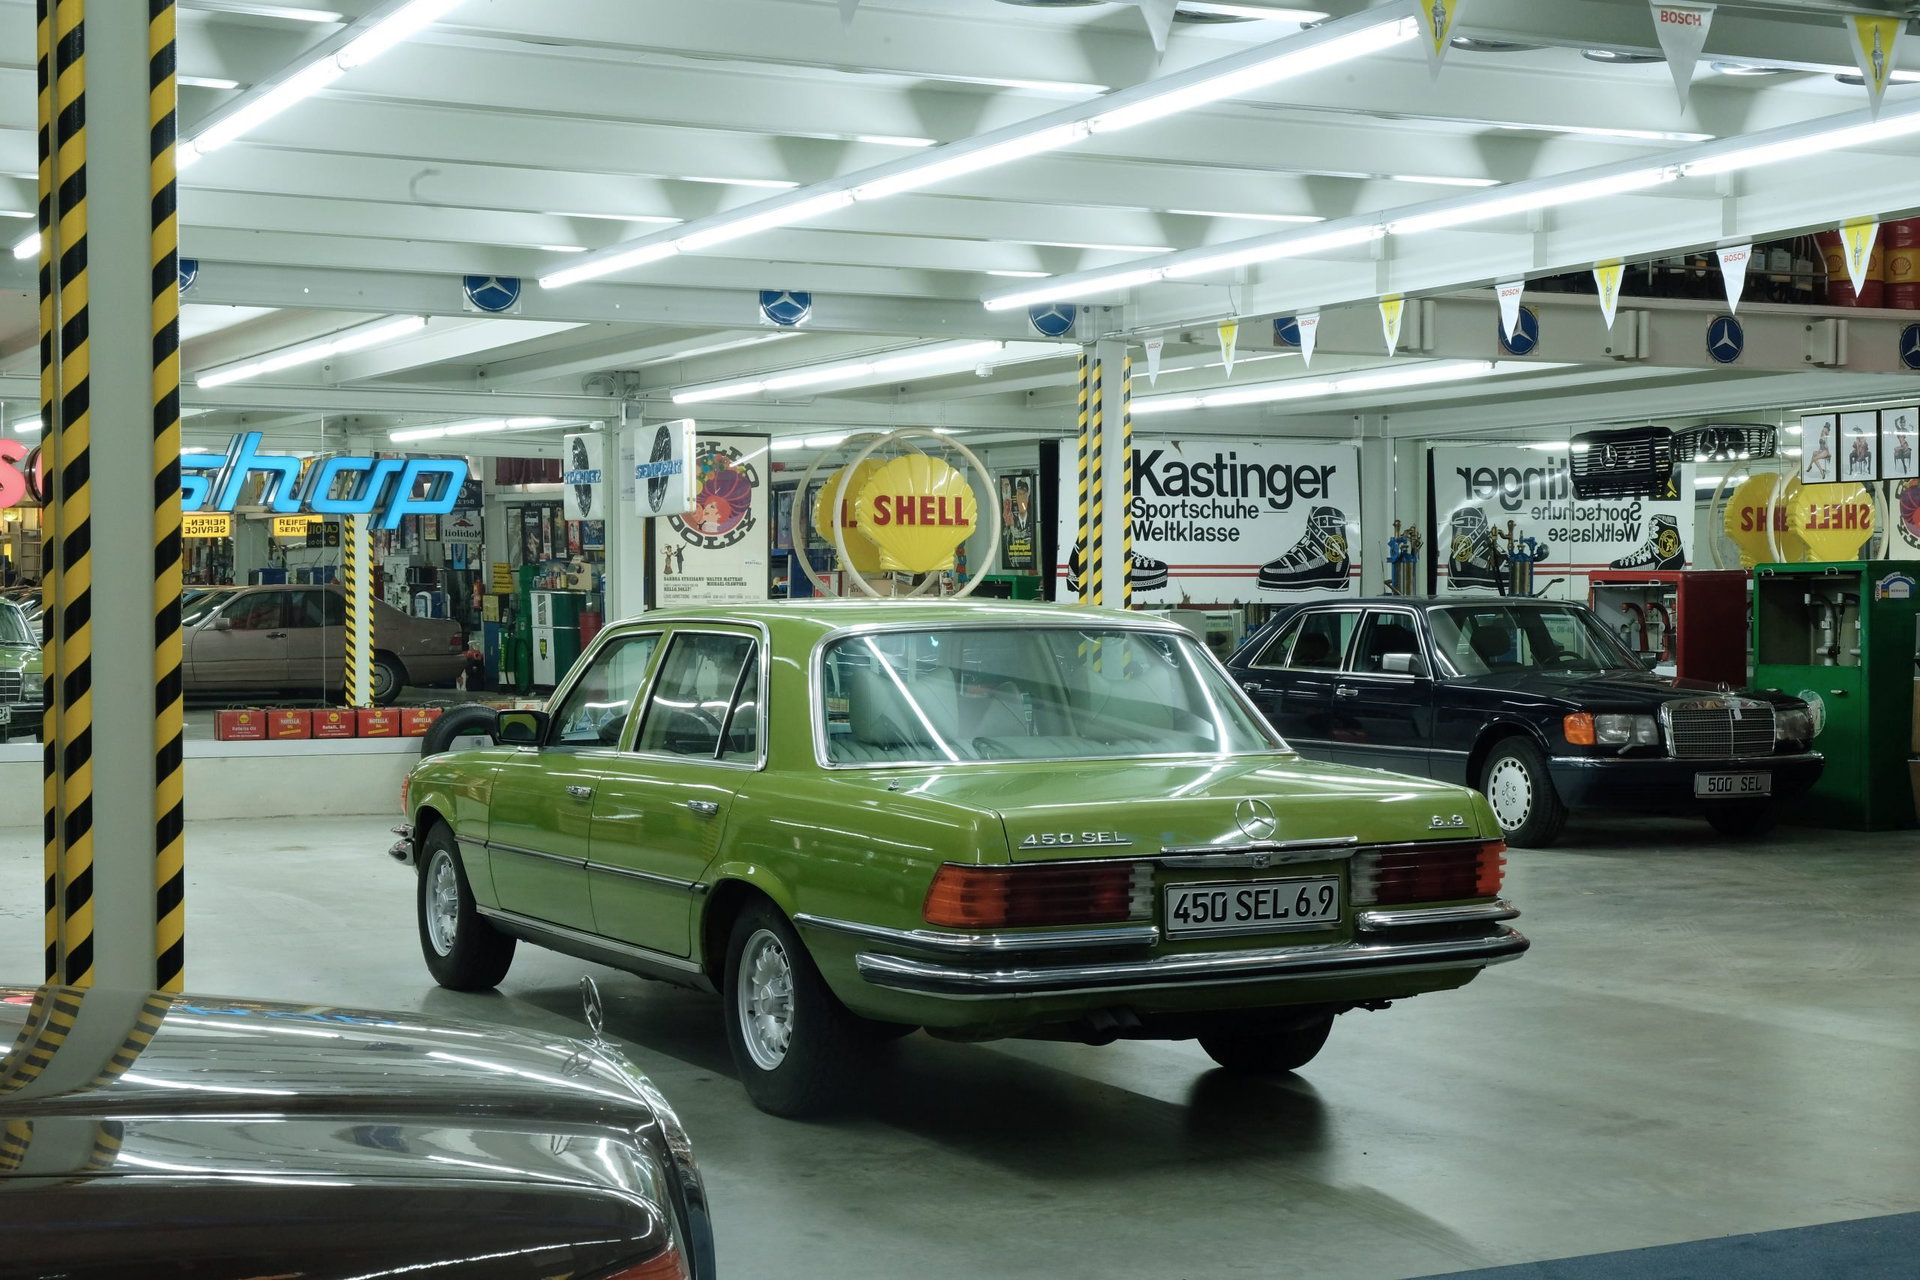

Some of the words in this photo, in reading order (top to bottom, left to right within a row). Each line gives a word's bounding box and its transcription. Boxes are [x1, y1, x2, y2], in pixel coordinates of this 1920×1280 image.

[1660, 10, 1702, 26] BOSCH
[1723, 251, 1747, 263] BOSCH
[1501, 288, 1520, 297] BOSCH
[1301, 319, 1316, 327] BOSCH
[1132, 449, 1336, 509] Kastinger
[873, 494, 969, 527] SHELL
[1131, 497, 1259, 521] Sportschuhe
[667, 507, 757, 549] DOLLY
[1131, 521, 1240, 542] Weltklasse
[1708, 776, 1733, 792] 500
[1740, 775, 1762, 792] SEL
[1433, 814, 1464, 827] 6.9
[1023, 833, 1074, 846] 450
[1081, 830, 1127, 844] SEL
[1173, 893, 1229, 924] 450
[1235, 890, 1289, 921] SEL
[1295, 885, 1335, 918] 6.9
